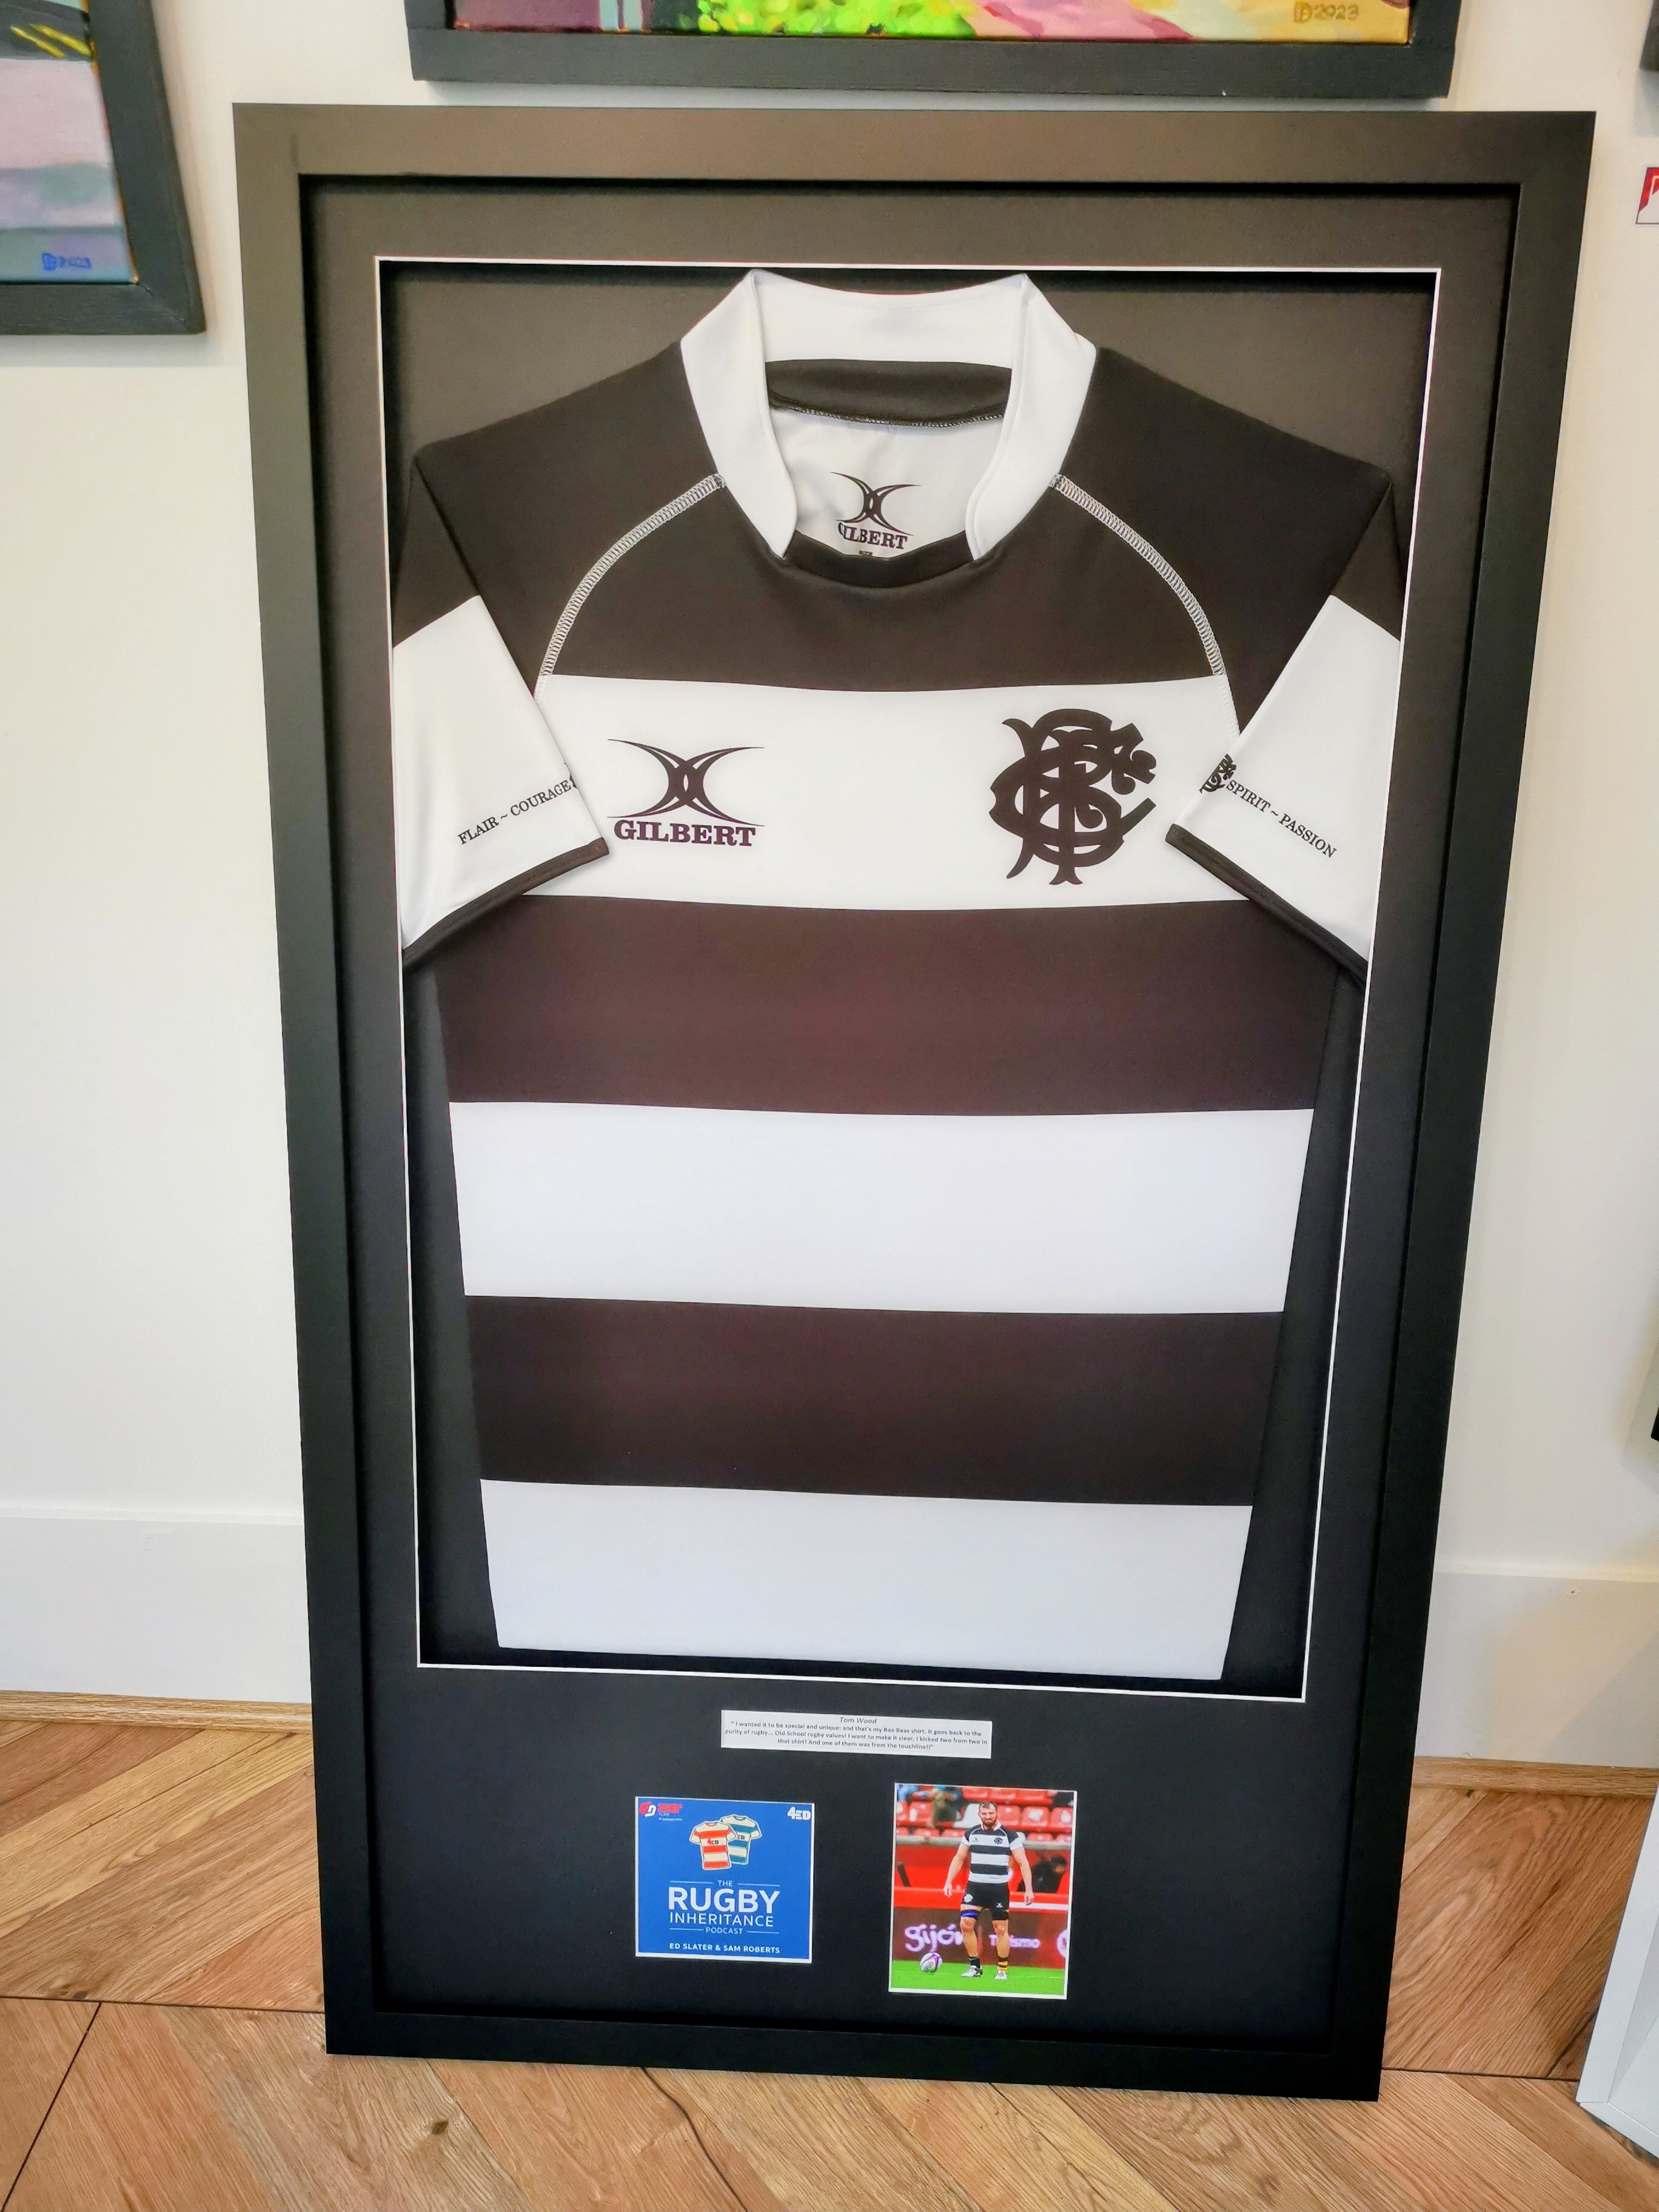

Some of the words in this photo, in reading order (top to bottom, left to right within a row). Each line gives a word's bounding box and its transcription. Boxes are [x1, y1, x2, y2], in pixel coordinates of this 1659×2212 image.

[457, 816, 499, 845] FLAIR
[510, 780, 571, 816] COURAGE
[1225, 780, 1271, 812] SPIRIT
[1279, 813, 1337, 858] PASSION
[614, 819, 756, 846] GILBERT
[787, 1806, 811, 1820] 4ED
[668, 1886, 780, 1914] RUGBY
[669, 1911, 774, 1927] INHERITANCE
